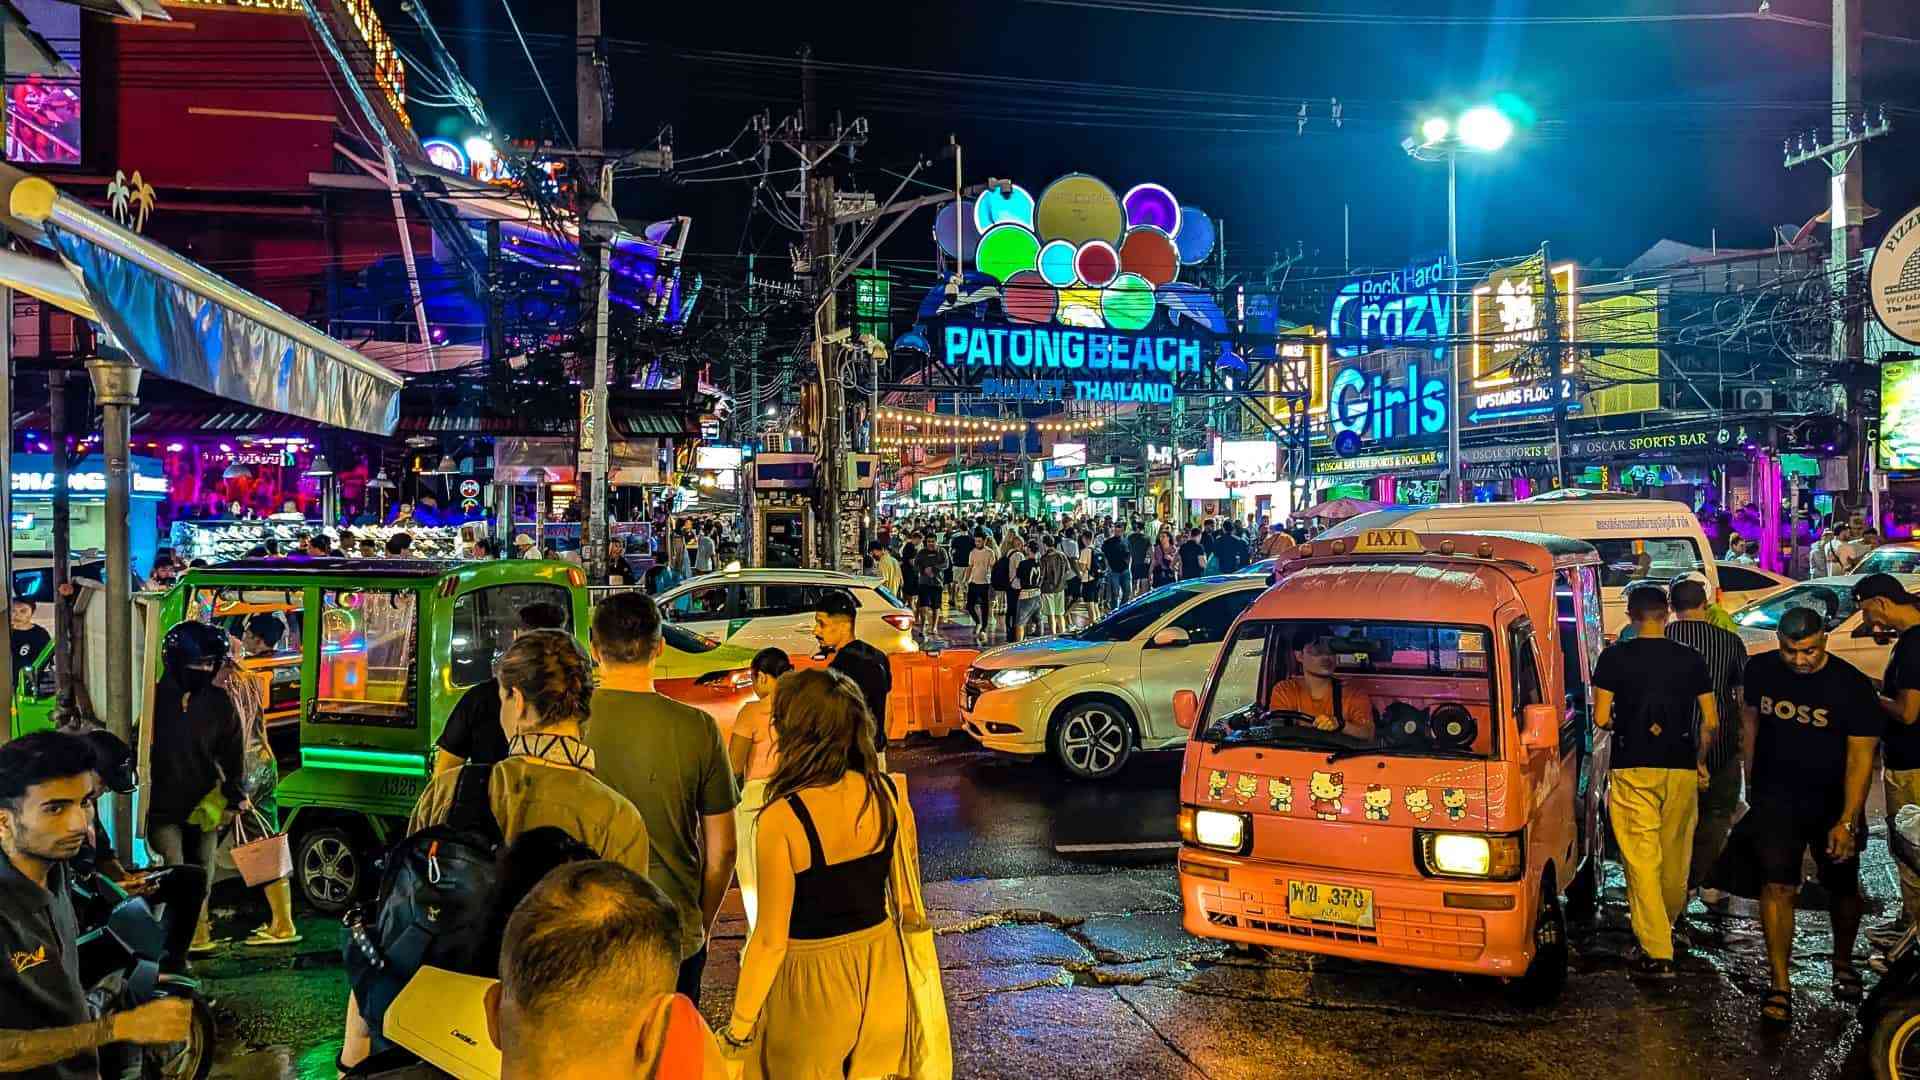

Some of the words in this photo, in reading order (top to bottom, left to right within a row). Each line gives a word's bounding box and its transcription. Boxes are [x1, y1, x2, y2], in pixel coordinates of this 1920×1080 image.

[1362, 272, 1400, 304] Rock
[1330, 282, 1452, 360] Crazy
[945, 326, 1085, 368] PATONG
[1088, 334, 1200, 372] BEACH
[1072, 380, 1174, 402] THAILAND
[1330, 364, 1446, 441] Girls
[1476, 390, 1521, 408] UPSTAIRS
[1561, 379, 1571, 398] 2
[1505, 442, 1541, 457] SPORTS
[1586, 440, 1627, 453] OSCAR
[1629, 435, 1676, 450] SPORTS
[1679, 432, 1709, 447] BAR
[1421, 452, 1437, 464] BAR
[1366, 530, 1408, 547] TAXI
[1760, 695, 1828, 728] BOSS
